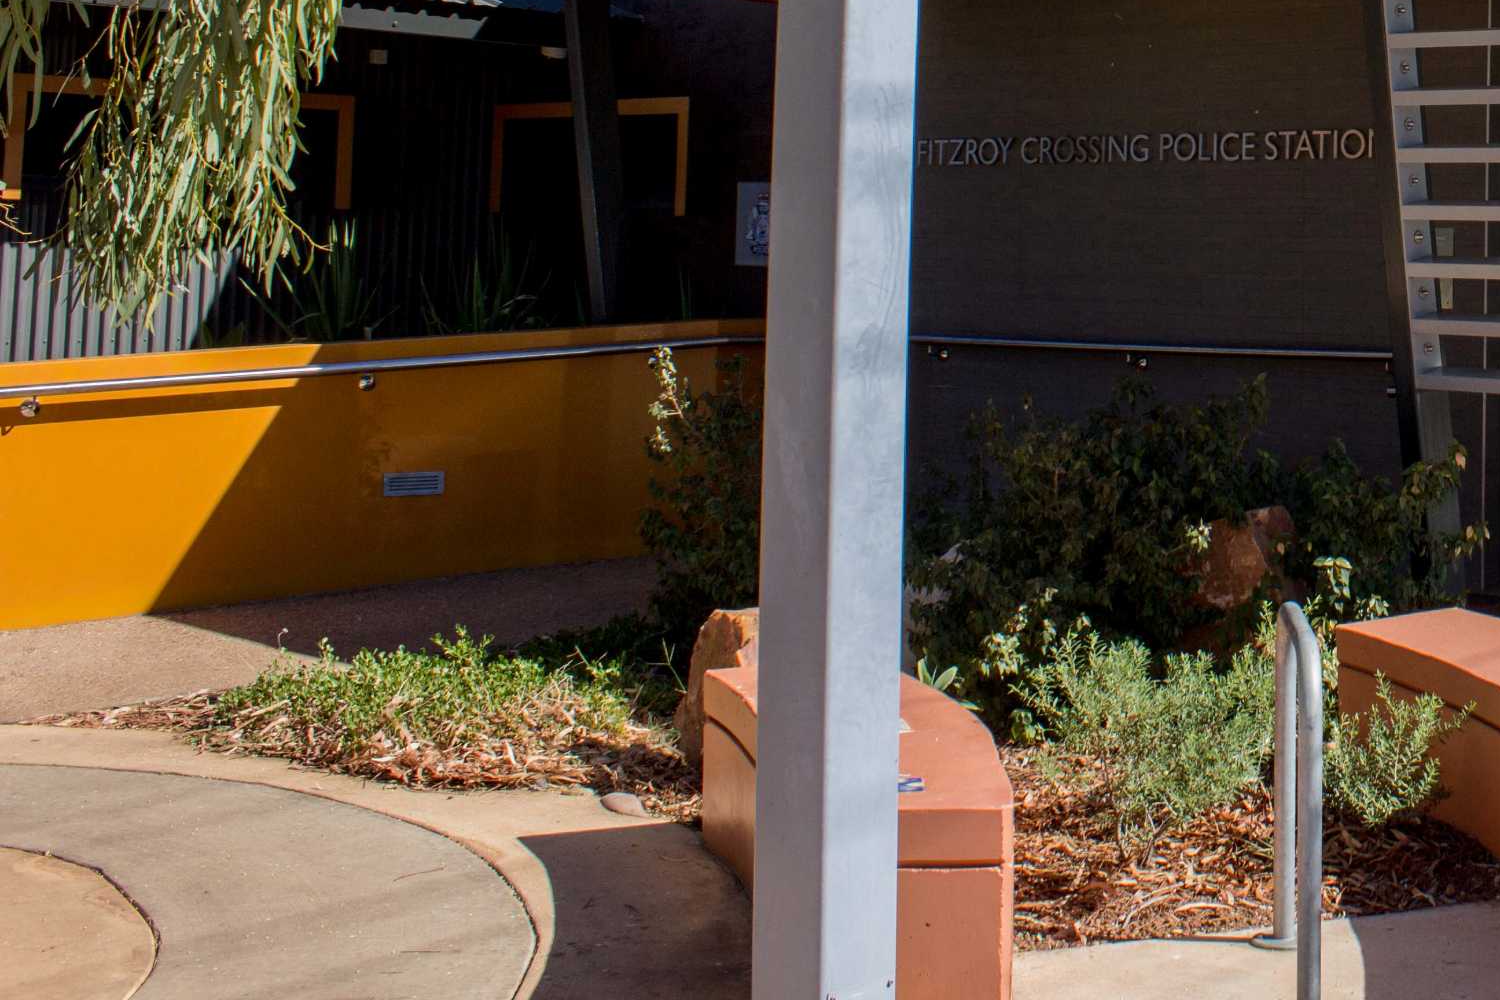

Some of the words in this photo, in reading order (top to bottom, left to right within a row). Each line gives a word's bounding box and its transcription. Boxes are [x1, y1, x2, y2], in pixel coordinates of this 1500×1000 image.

[917, 137, 1014, 165] FITZROY
[1021, 134, 1150, 164] CROSSING
[1159, 132, 1256, 161] POLICE
